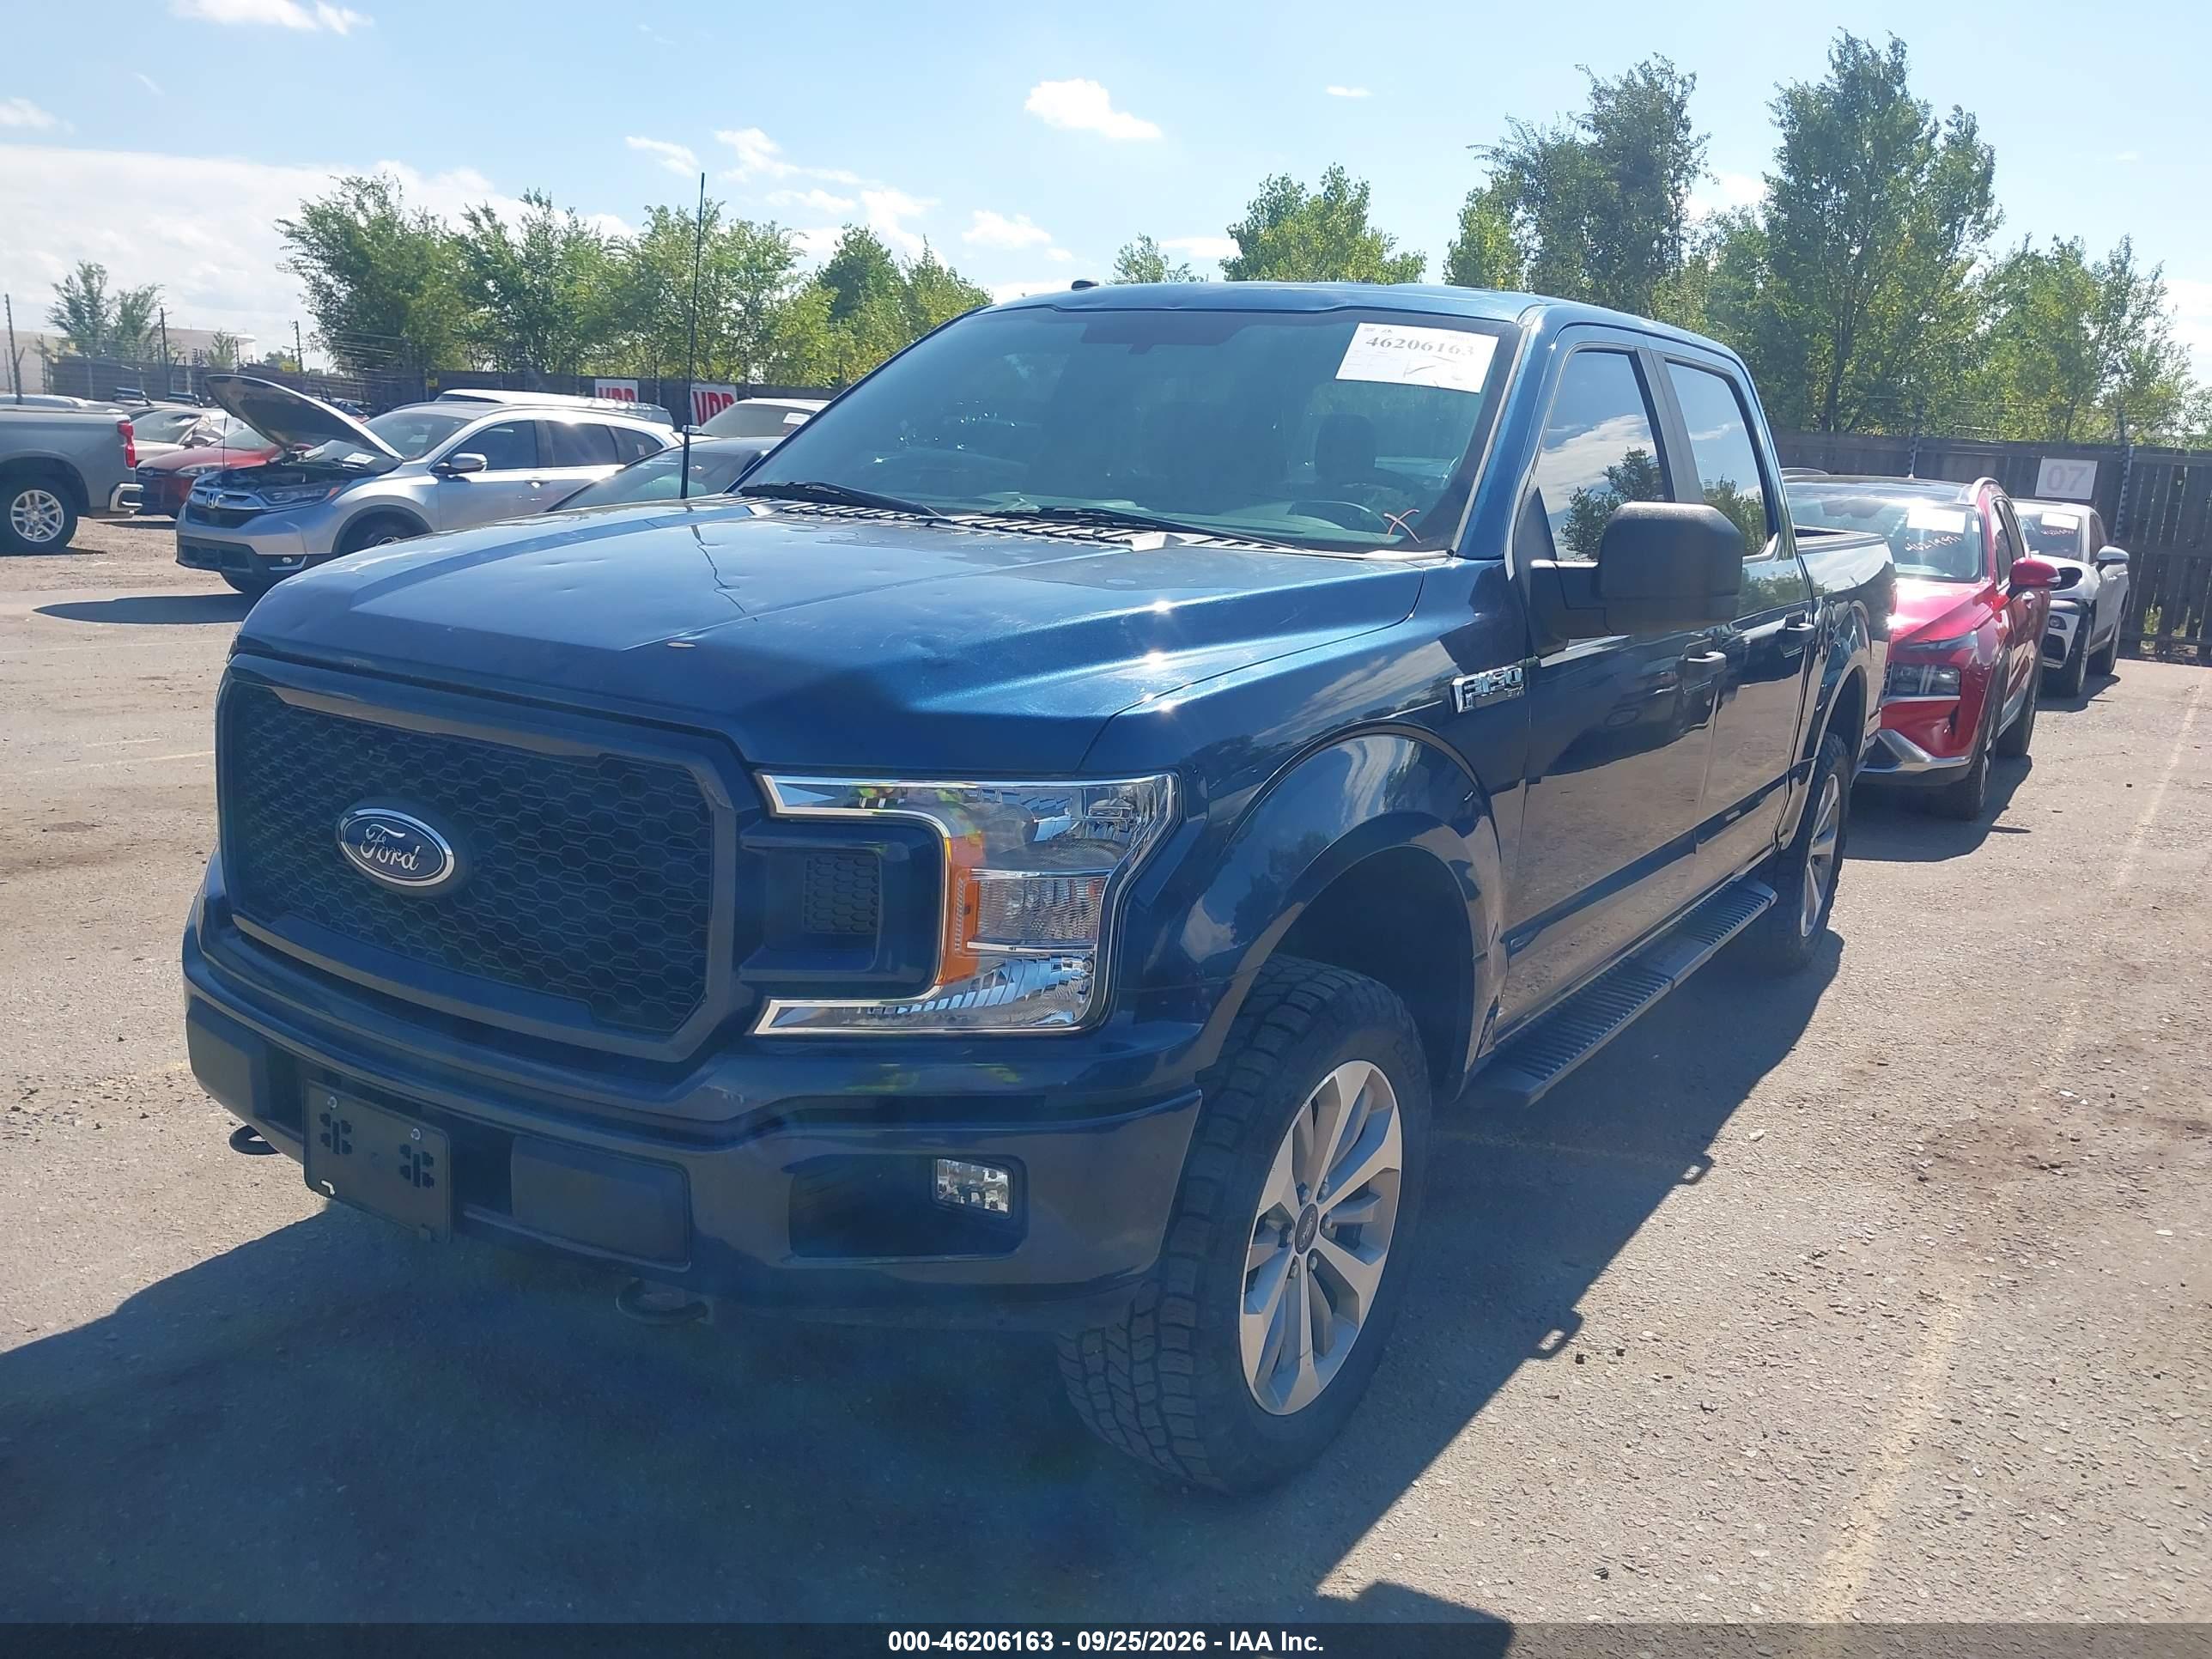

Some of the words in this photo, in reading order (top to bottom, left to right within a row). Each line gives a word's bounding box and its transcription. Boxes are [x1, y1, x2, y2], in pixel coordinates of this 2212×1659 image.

[1365, 336, 1474, 356] 46206163
[2047, 465, 2087, 492] 07
[360, 823, 421, 871] Ford
